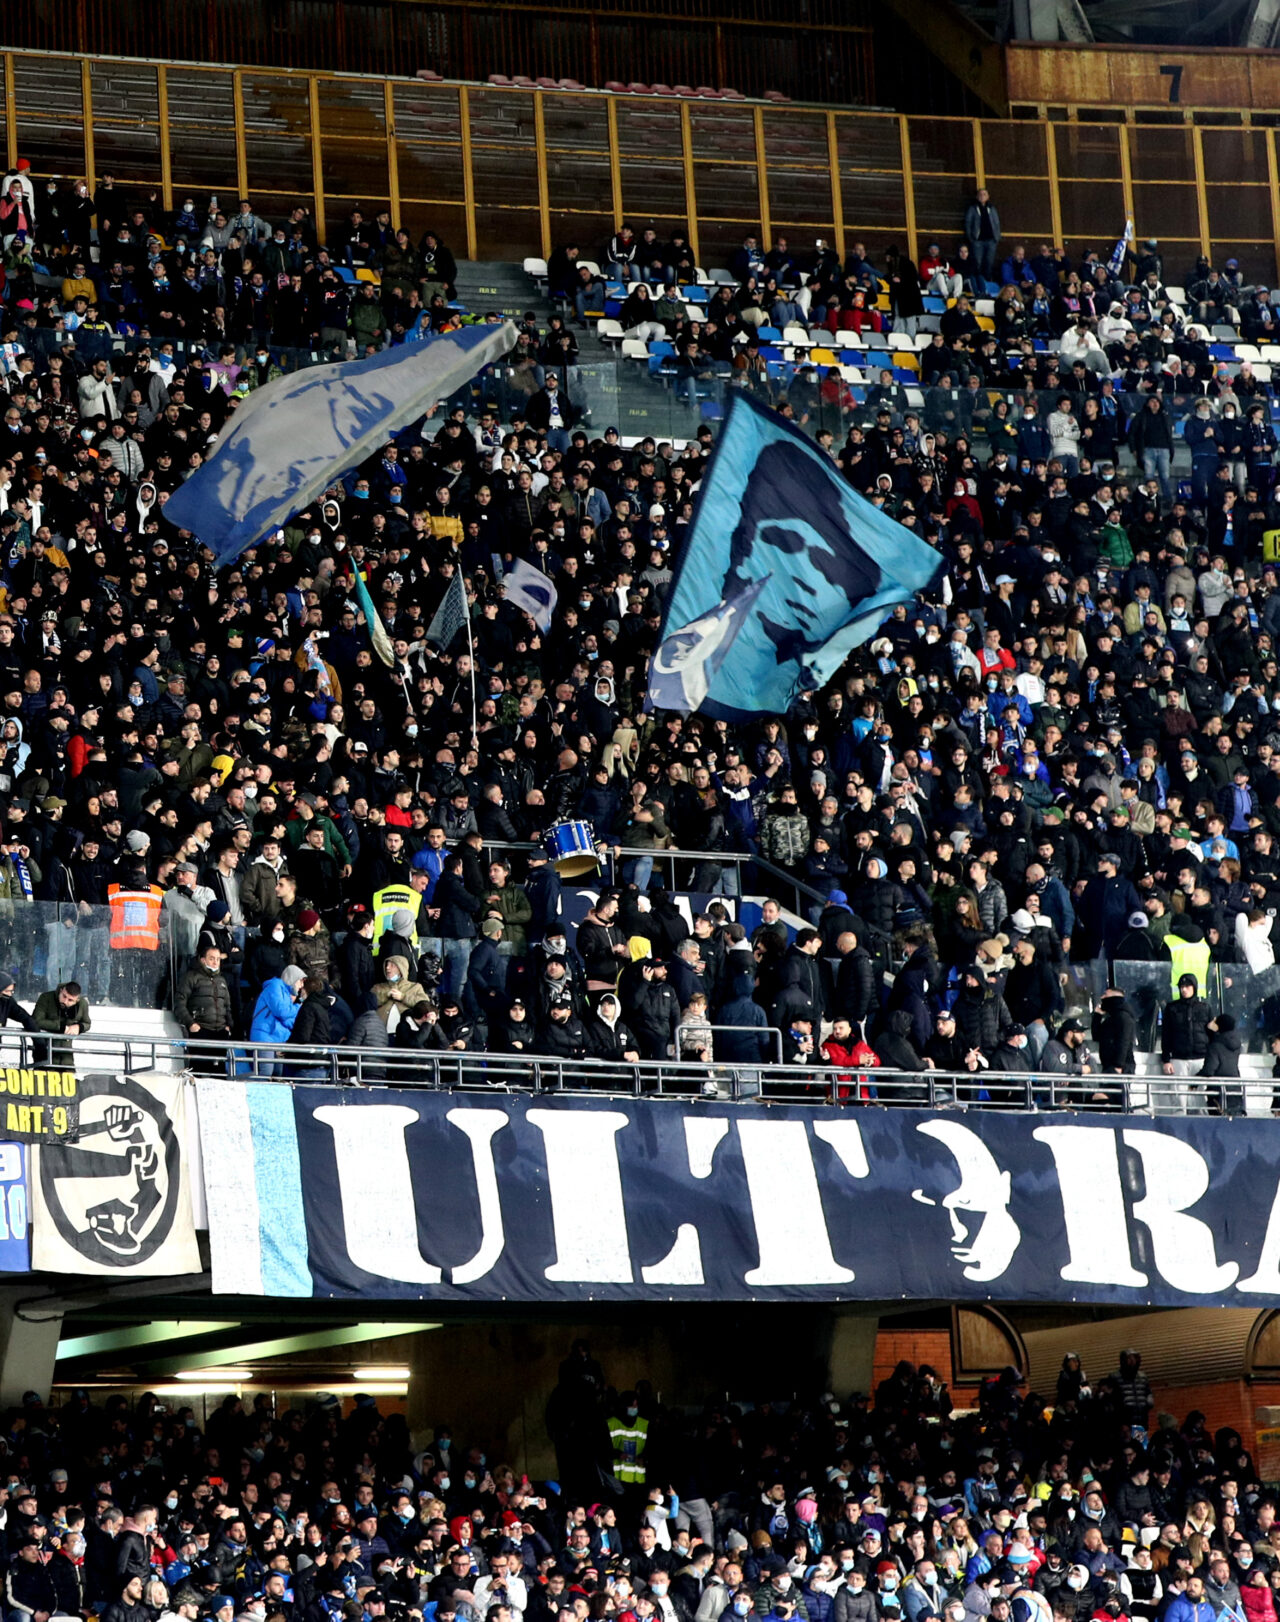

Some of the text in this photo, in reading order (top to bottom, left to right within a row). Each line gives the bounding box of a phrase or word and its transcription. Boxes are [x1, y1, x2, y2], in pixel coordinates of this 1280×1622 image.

[1159, 66, 1184, 103] 7
[6, 1103, 68, 1135] ART. 9
